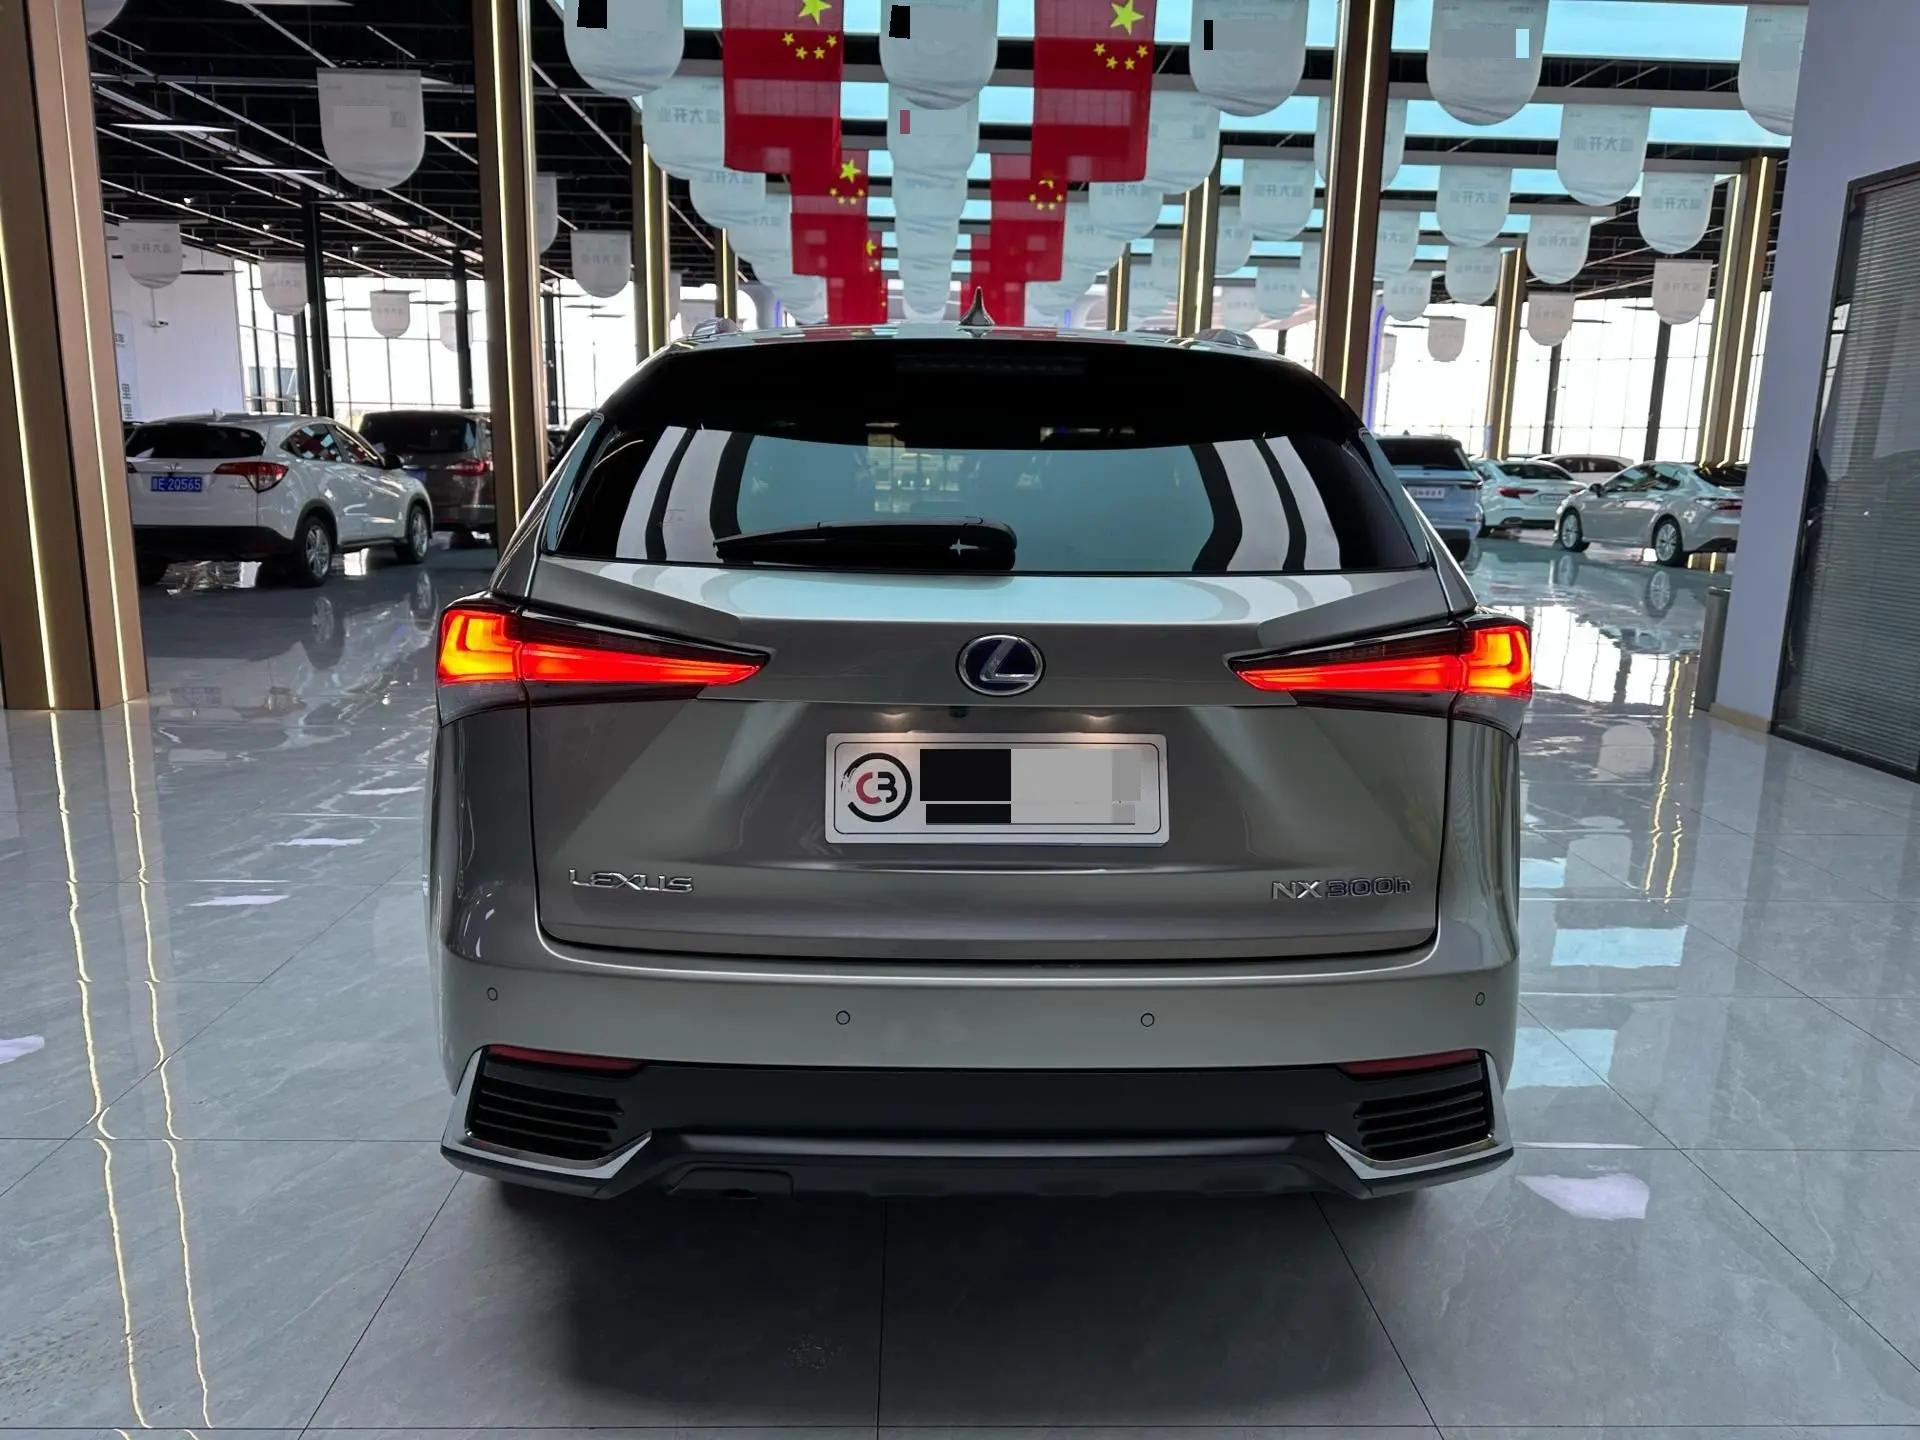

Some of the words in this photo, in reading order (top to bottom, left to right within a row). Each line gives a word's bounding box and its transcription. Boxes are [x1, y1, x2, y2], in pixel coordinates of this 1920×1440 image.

[569, 869, 693, 893] LEXUS
[1272, 881, 1322, 899] NX
[1327, 878, 1412, 898] 300h
